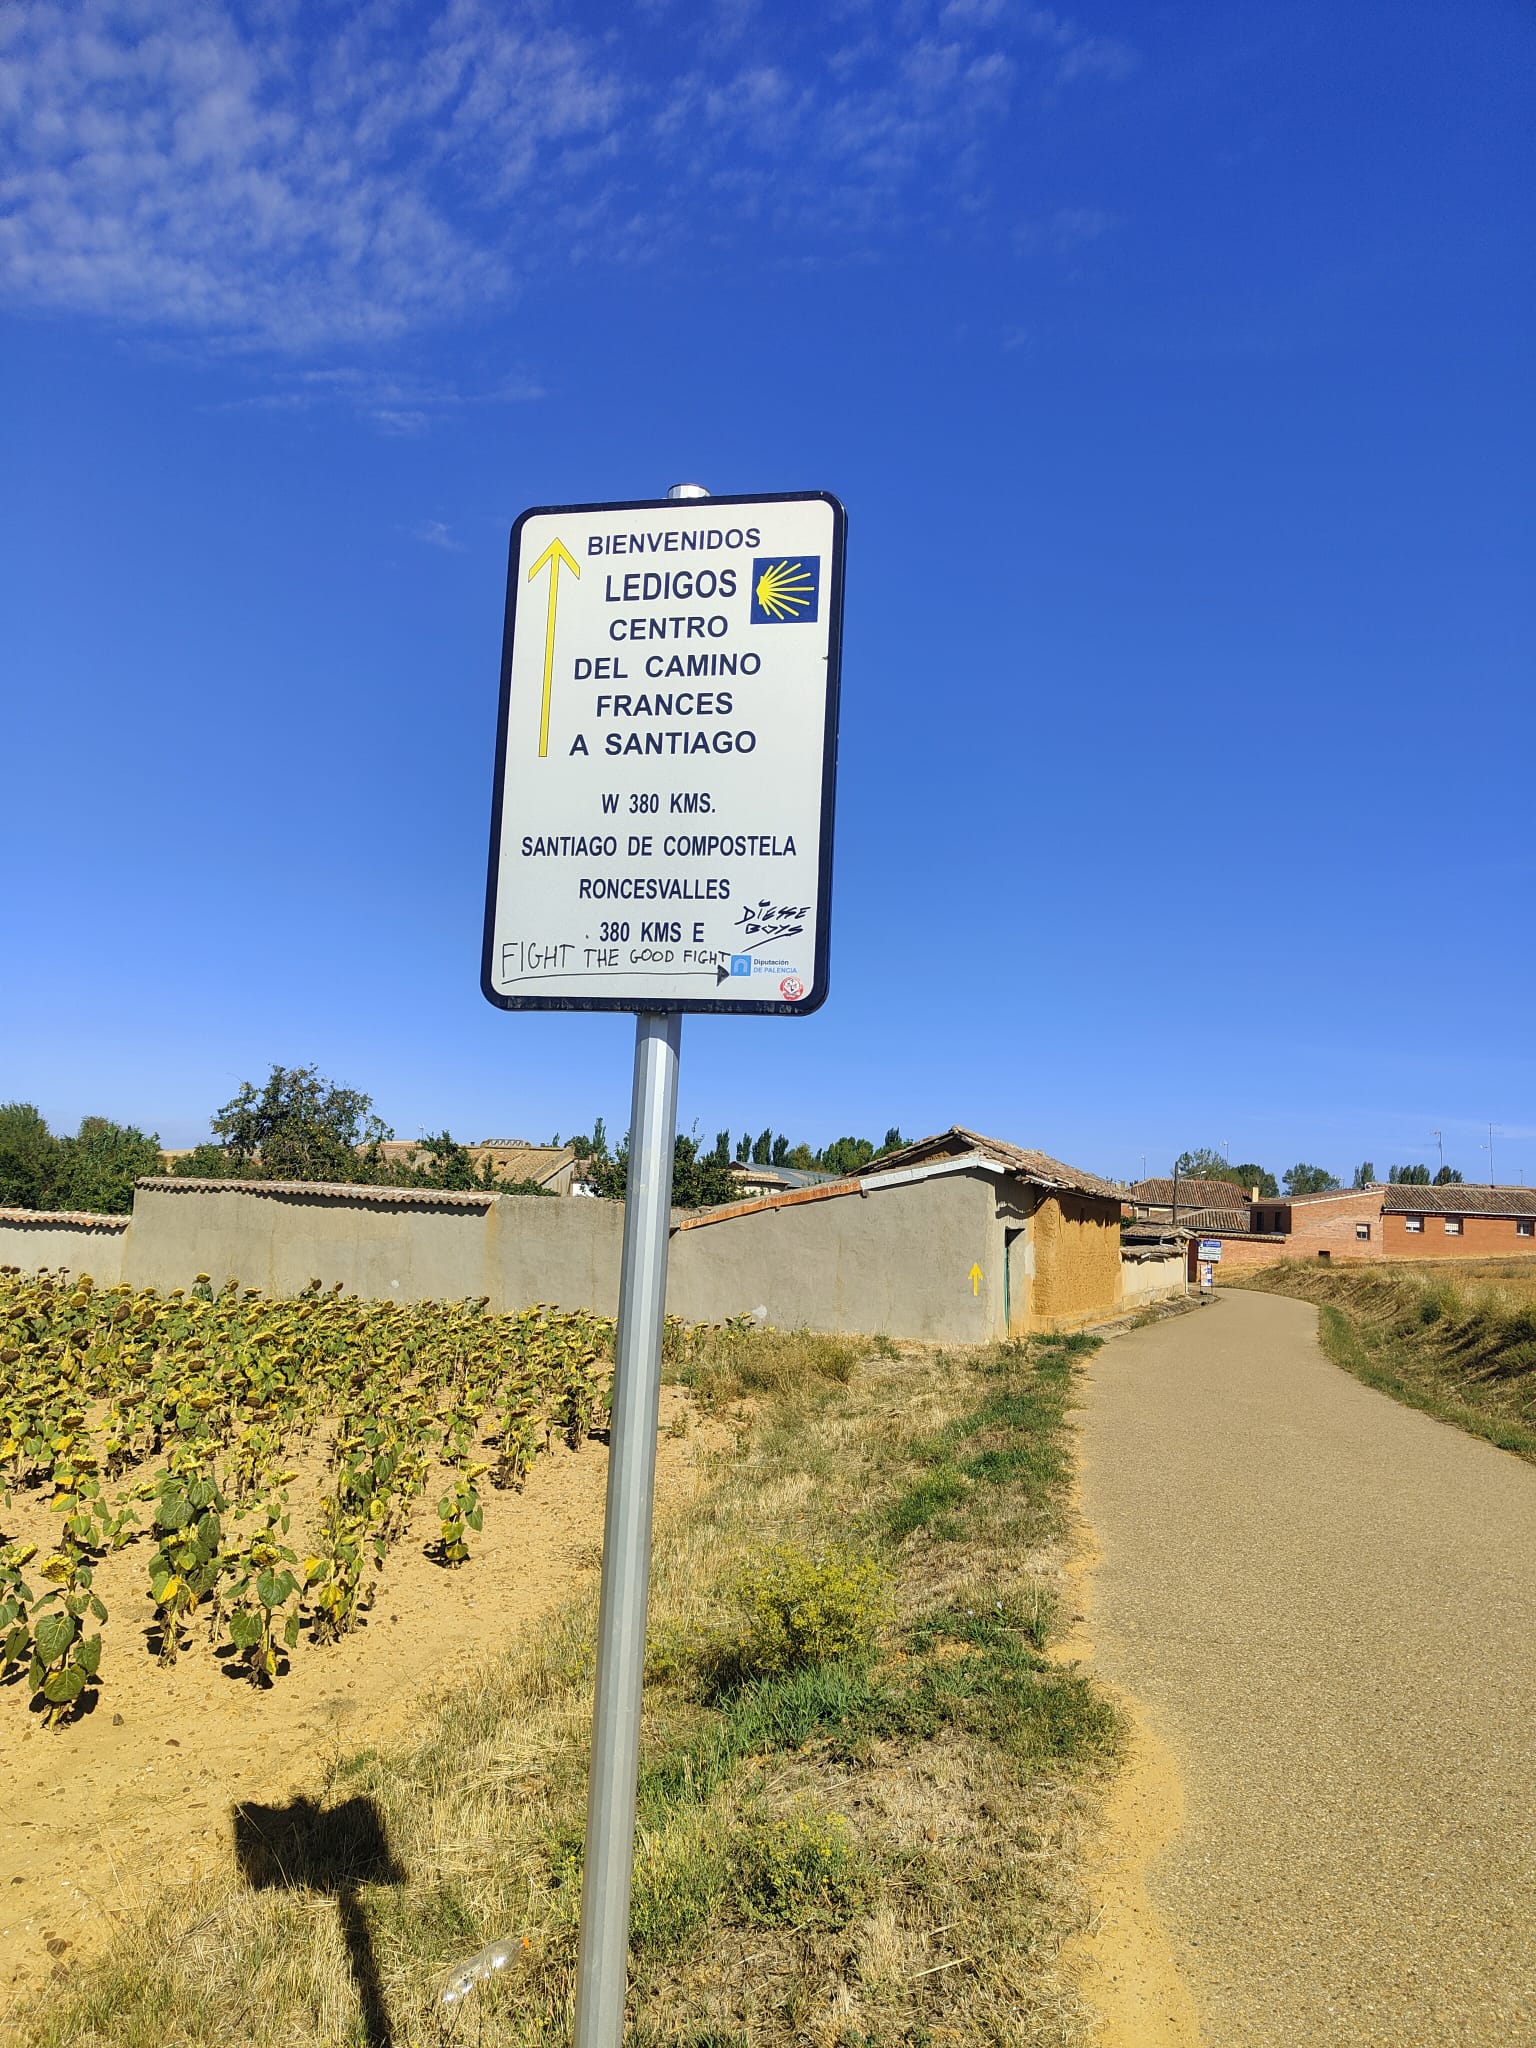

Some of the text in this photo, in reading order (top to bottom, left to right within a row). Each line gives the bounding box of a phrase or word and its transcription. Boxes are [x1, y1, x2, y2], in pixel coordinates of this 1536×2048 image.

[588, 528, 761, 555] BIENVENIDOS
[605, 569, 737, 602] LEDIGOS
[609, 616, 728, 641] CENTRO
[574, 653, 761, 680] DEL CAMINO
[596, 692, 733, 717] FRANCES
[569, 731, 756, 756] A SANTIAGO
[602, 793, 716, 814] W 380 KMS.
[522, 836, 796, 857] SANTIAGO DE COMPOSTELA
[579, 879, 730, 900] RONCESVALLES
[600, 922, 705, 943] 380 KMS E
[745, 923, 804, 937] BOYS
[502, 941, 731, 978] FIGHT THE GOOD FIGHT
[753, 958, 789, 966] Diputación
